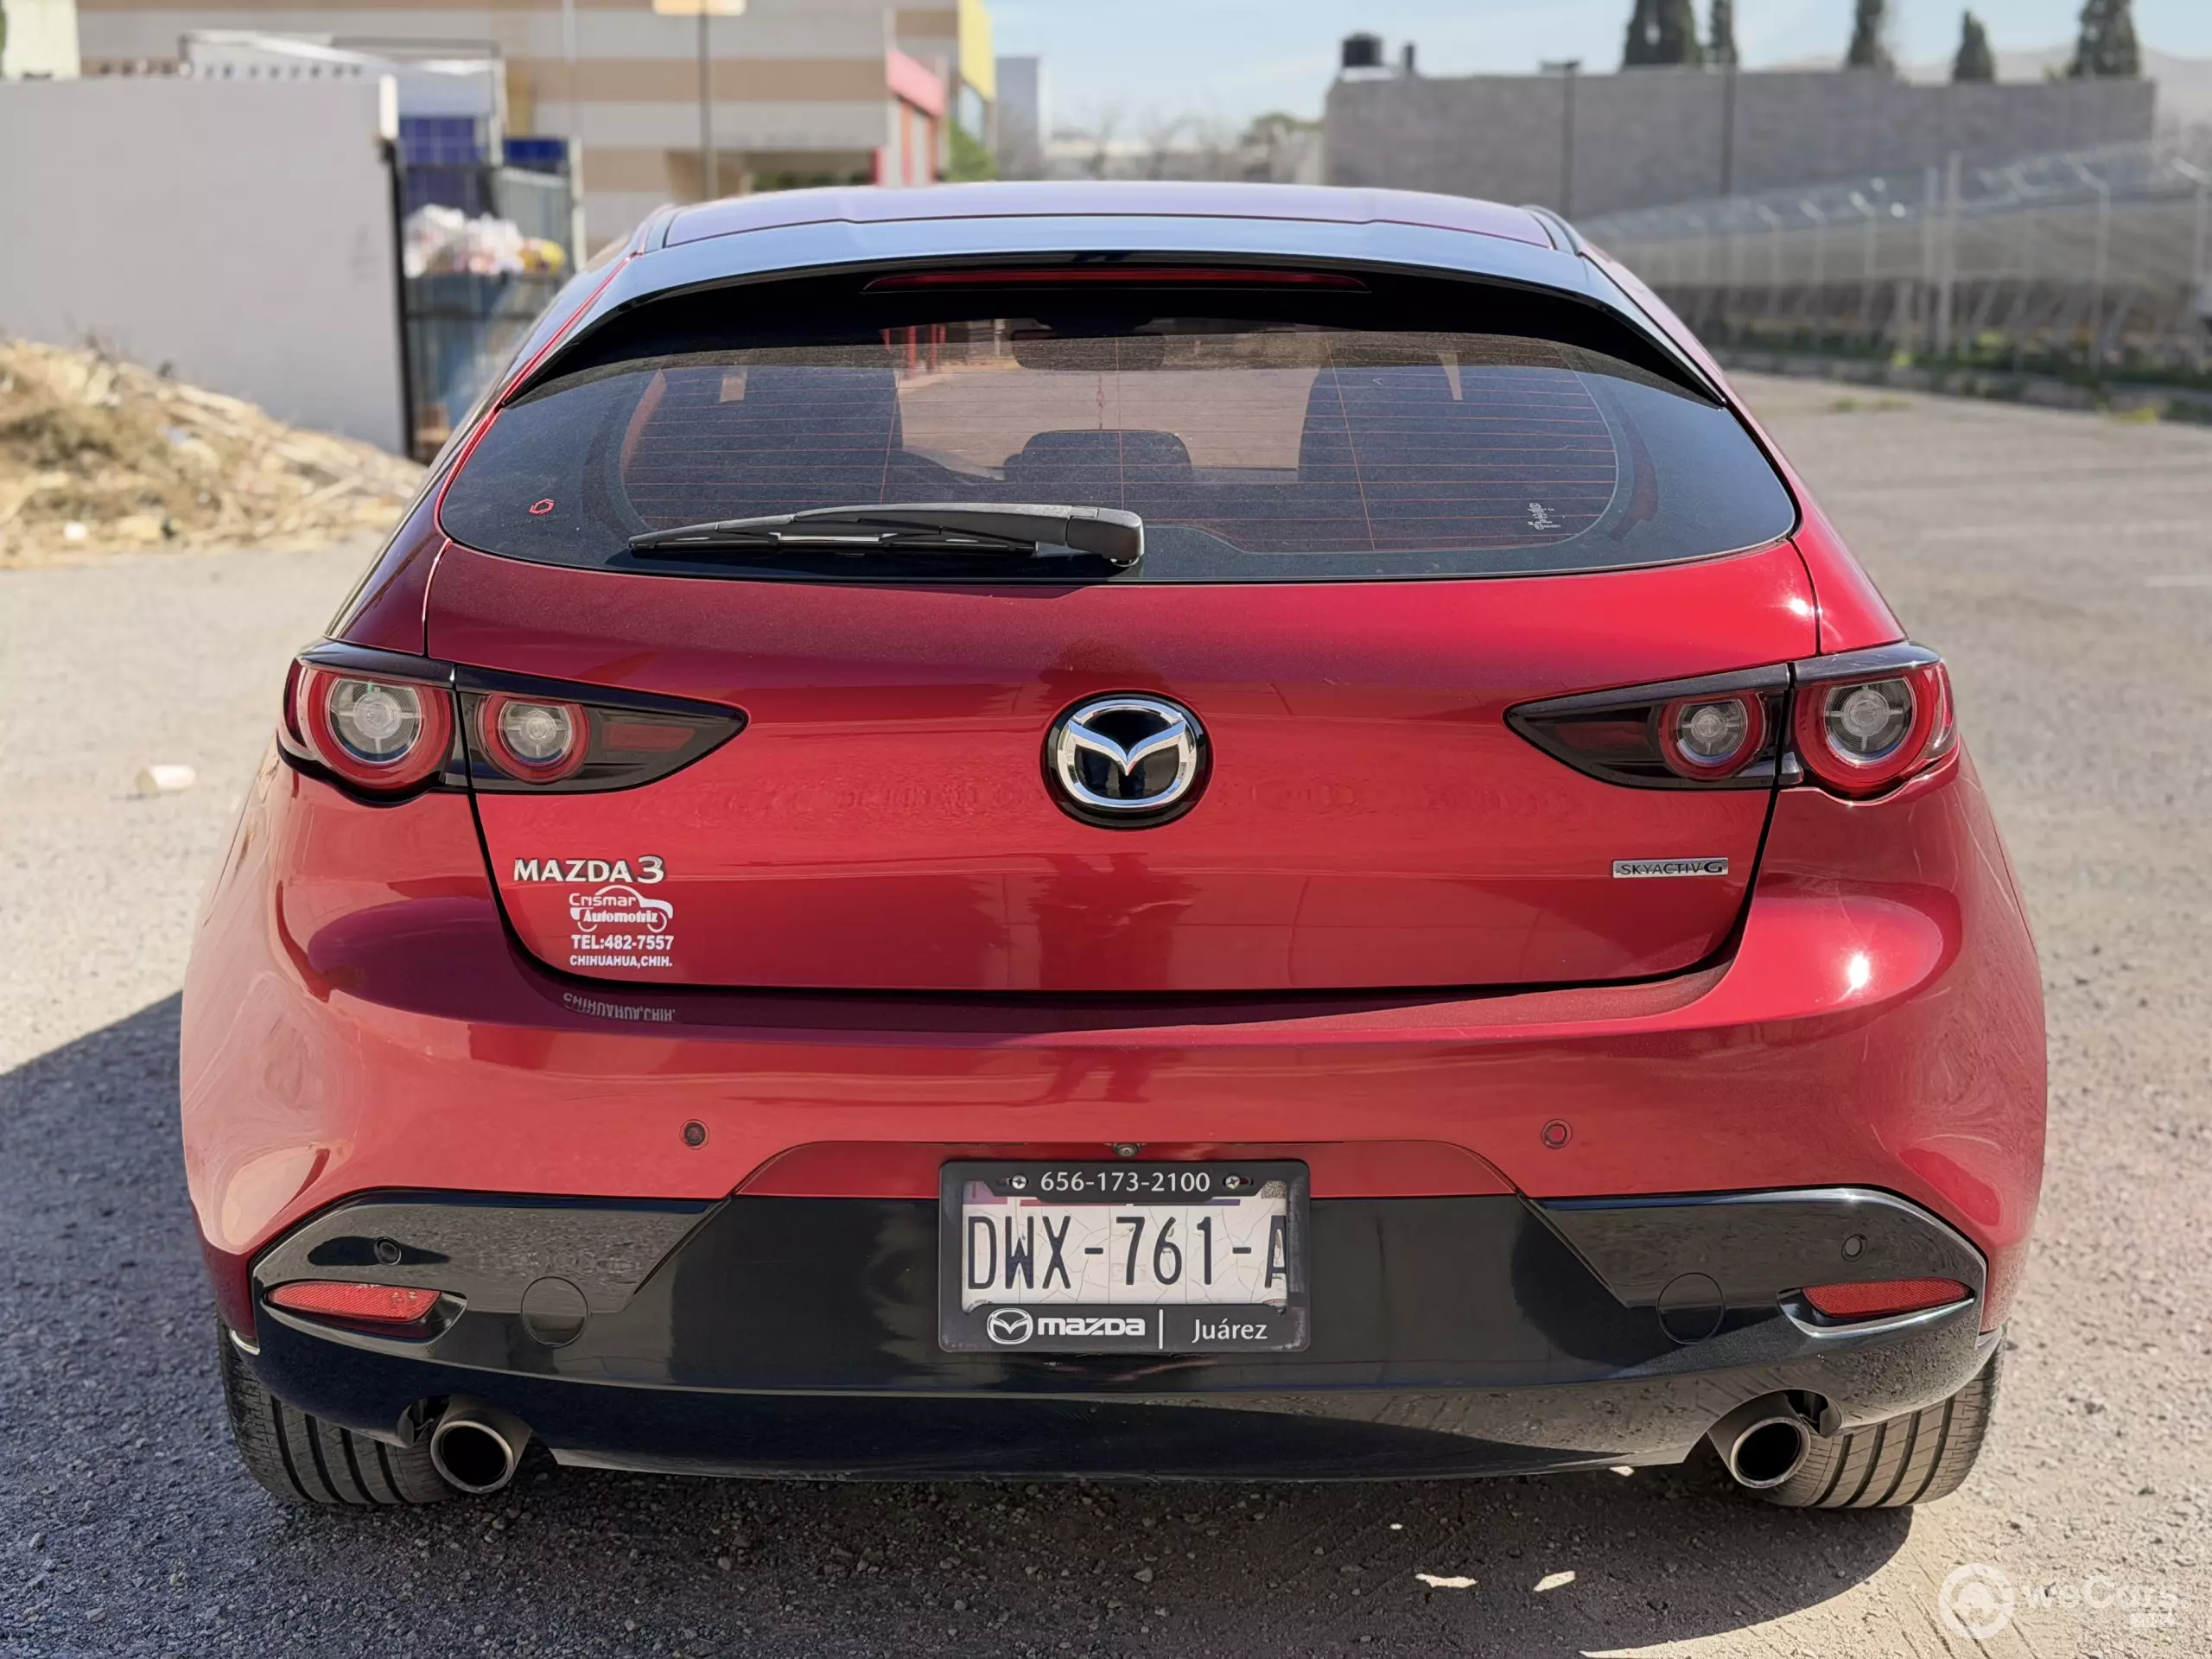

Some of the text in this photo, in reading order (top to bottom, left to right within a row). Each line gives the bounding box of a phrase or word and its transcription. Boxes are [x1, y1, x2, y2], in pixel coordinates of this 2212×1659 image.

[514, 855, 665, 884] MAZDA 3
[569, 893, 637, 906] Crismar
[583, 910, 658, 924] Automotriz
[571, 935, 674, 950] TEL:482-7557
[1040, 1172, 1210, 1192] 656-173-2100
[967, 1215, 1287, 1290] DWX-761-A
[1192, 1318, 1268, 1344] Juárez
